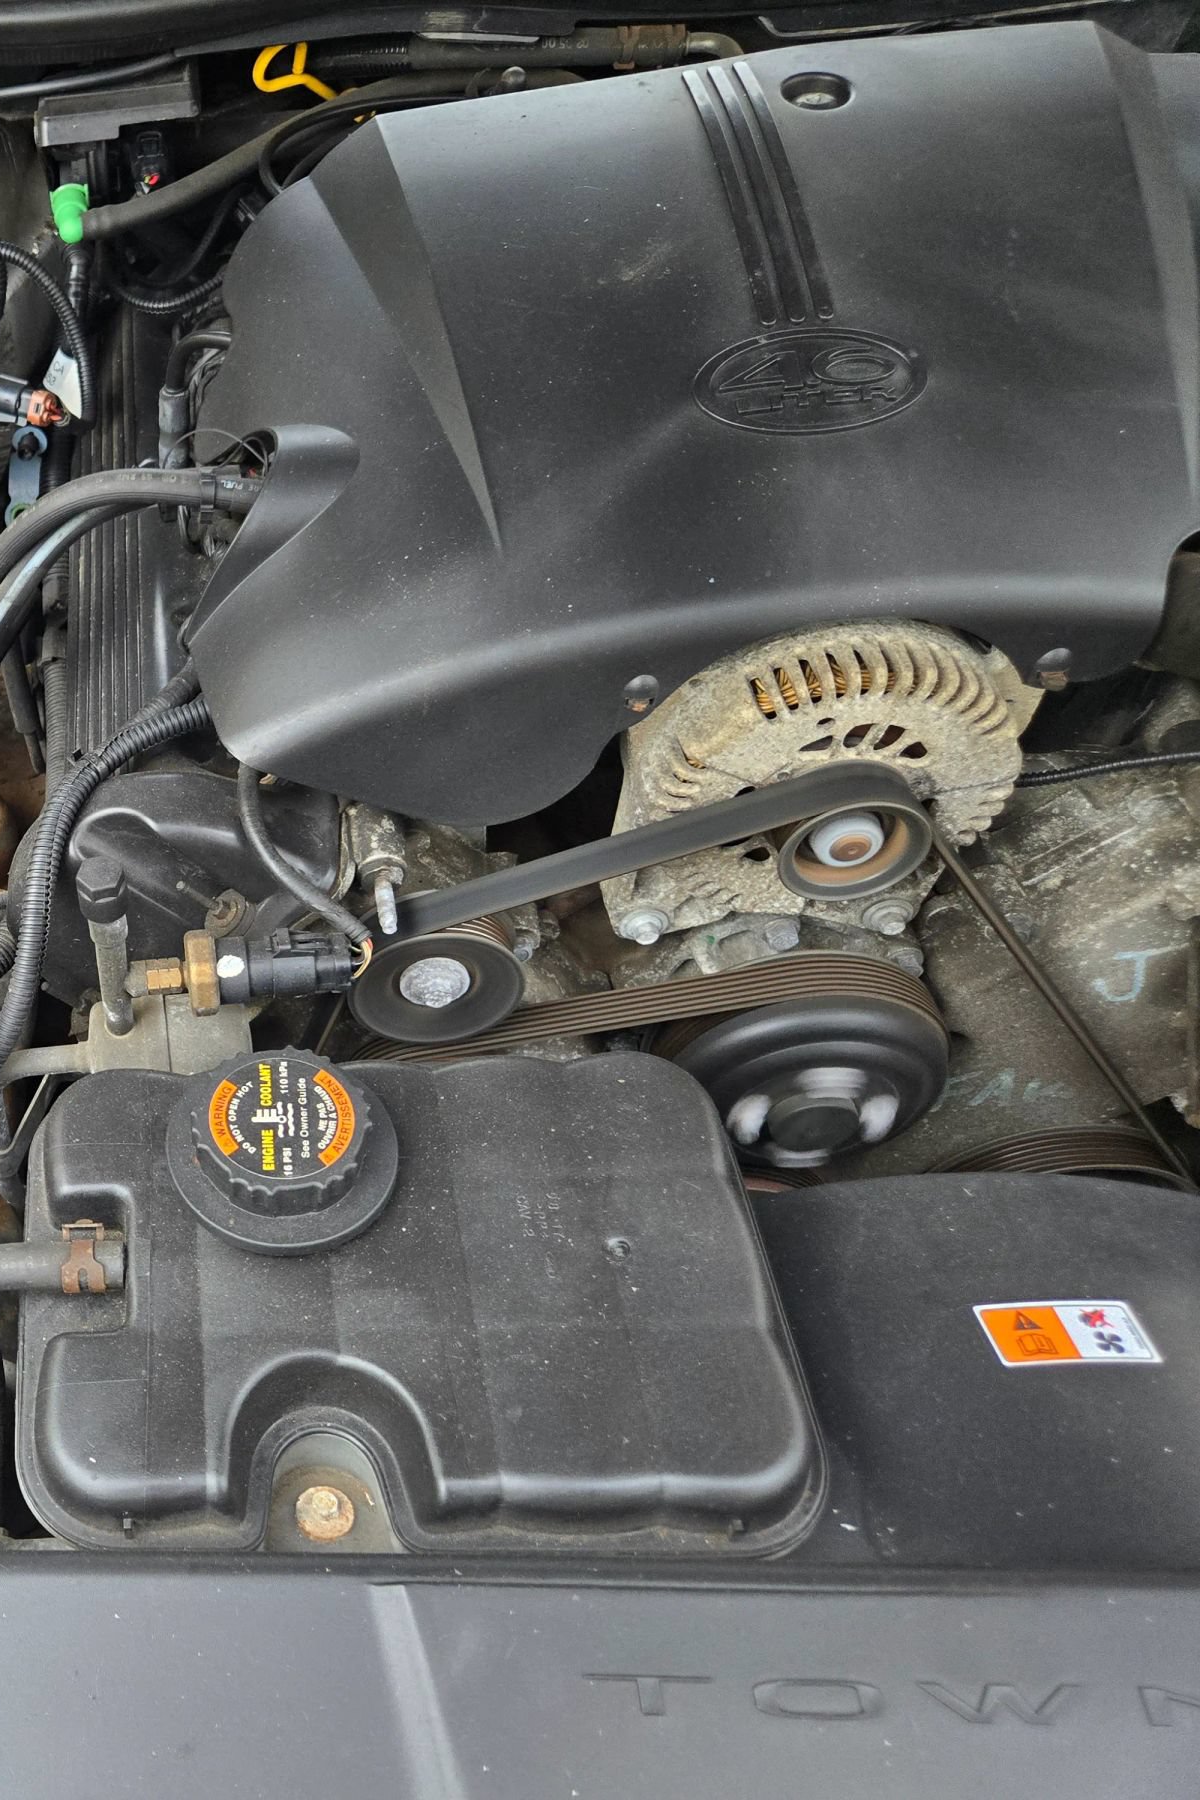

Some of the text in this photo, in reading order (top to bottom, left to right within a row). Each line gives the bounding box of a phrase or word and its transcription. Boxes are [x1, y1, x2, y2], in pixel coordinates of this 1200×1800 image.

[280, 1079, 289, 1094] 110
[314, 1085, 336, 1111] CHAUD
[214, 1086, 232, 1137] WARNING
[228, 1081, 257, 1154] DO NOT OPEN HOT
[259, 1064, 276, 1171] ENGINE COOLANT
[297, 1078, 310, 1158] See Owner Guide
[319, 1076, 352, 1152] AVERTISSEMENT
[318, 1120, 337, 1149] OUVRIR
[283, 1148, 292, 1163] PSI
[283, 1164, 293, 1176] 16
